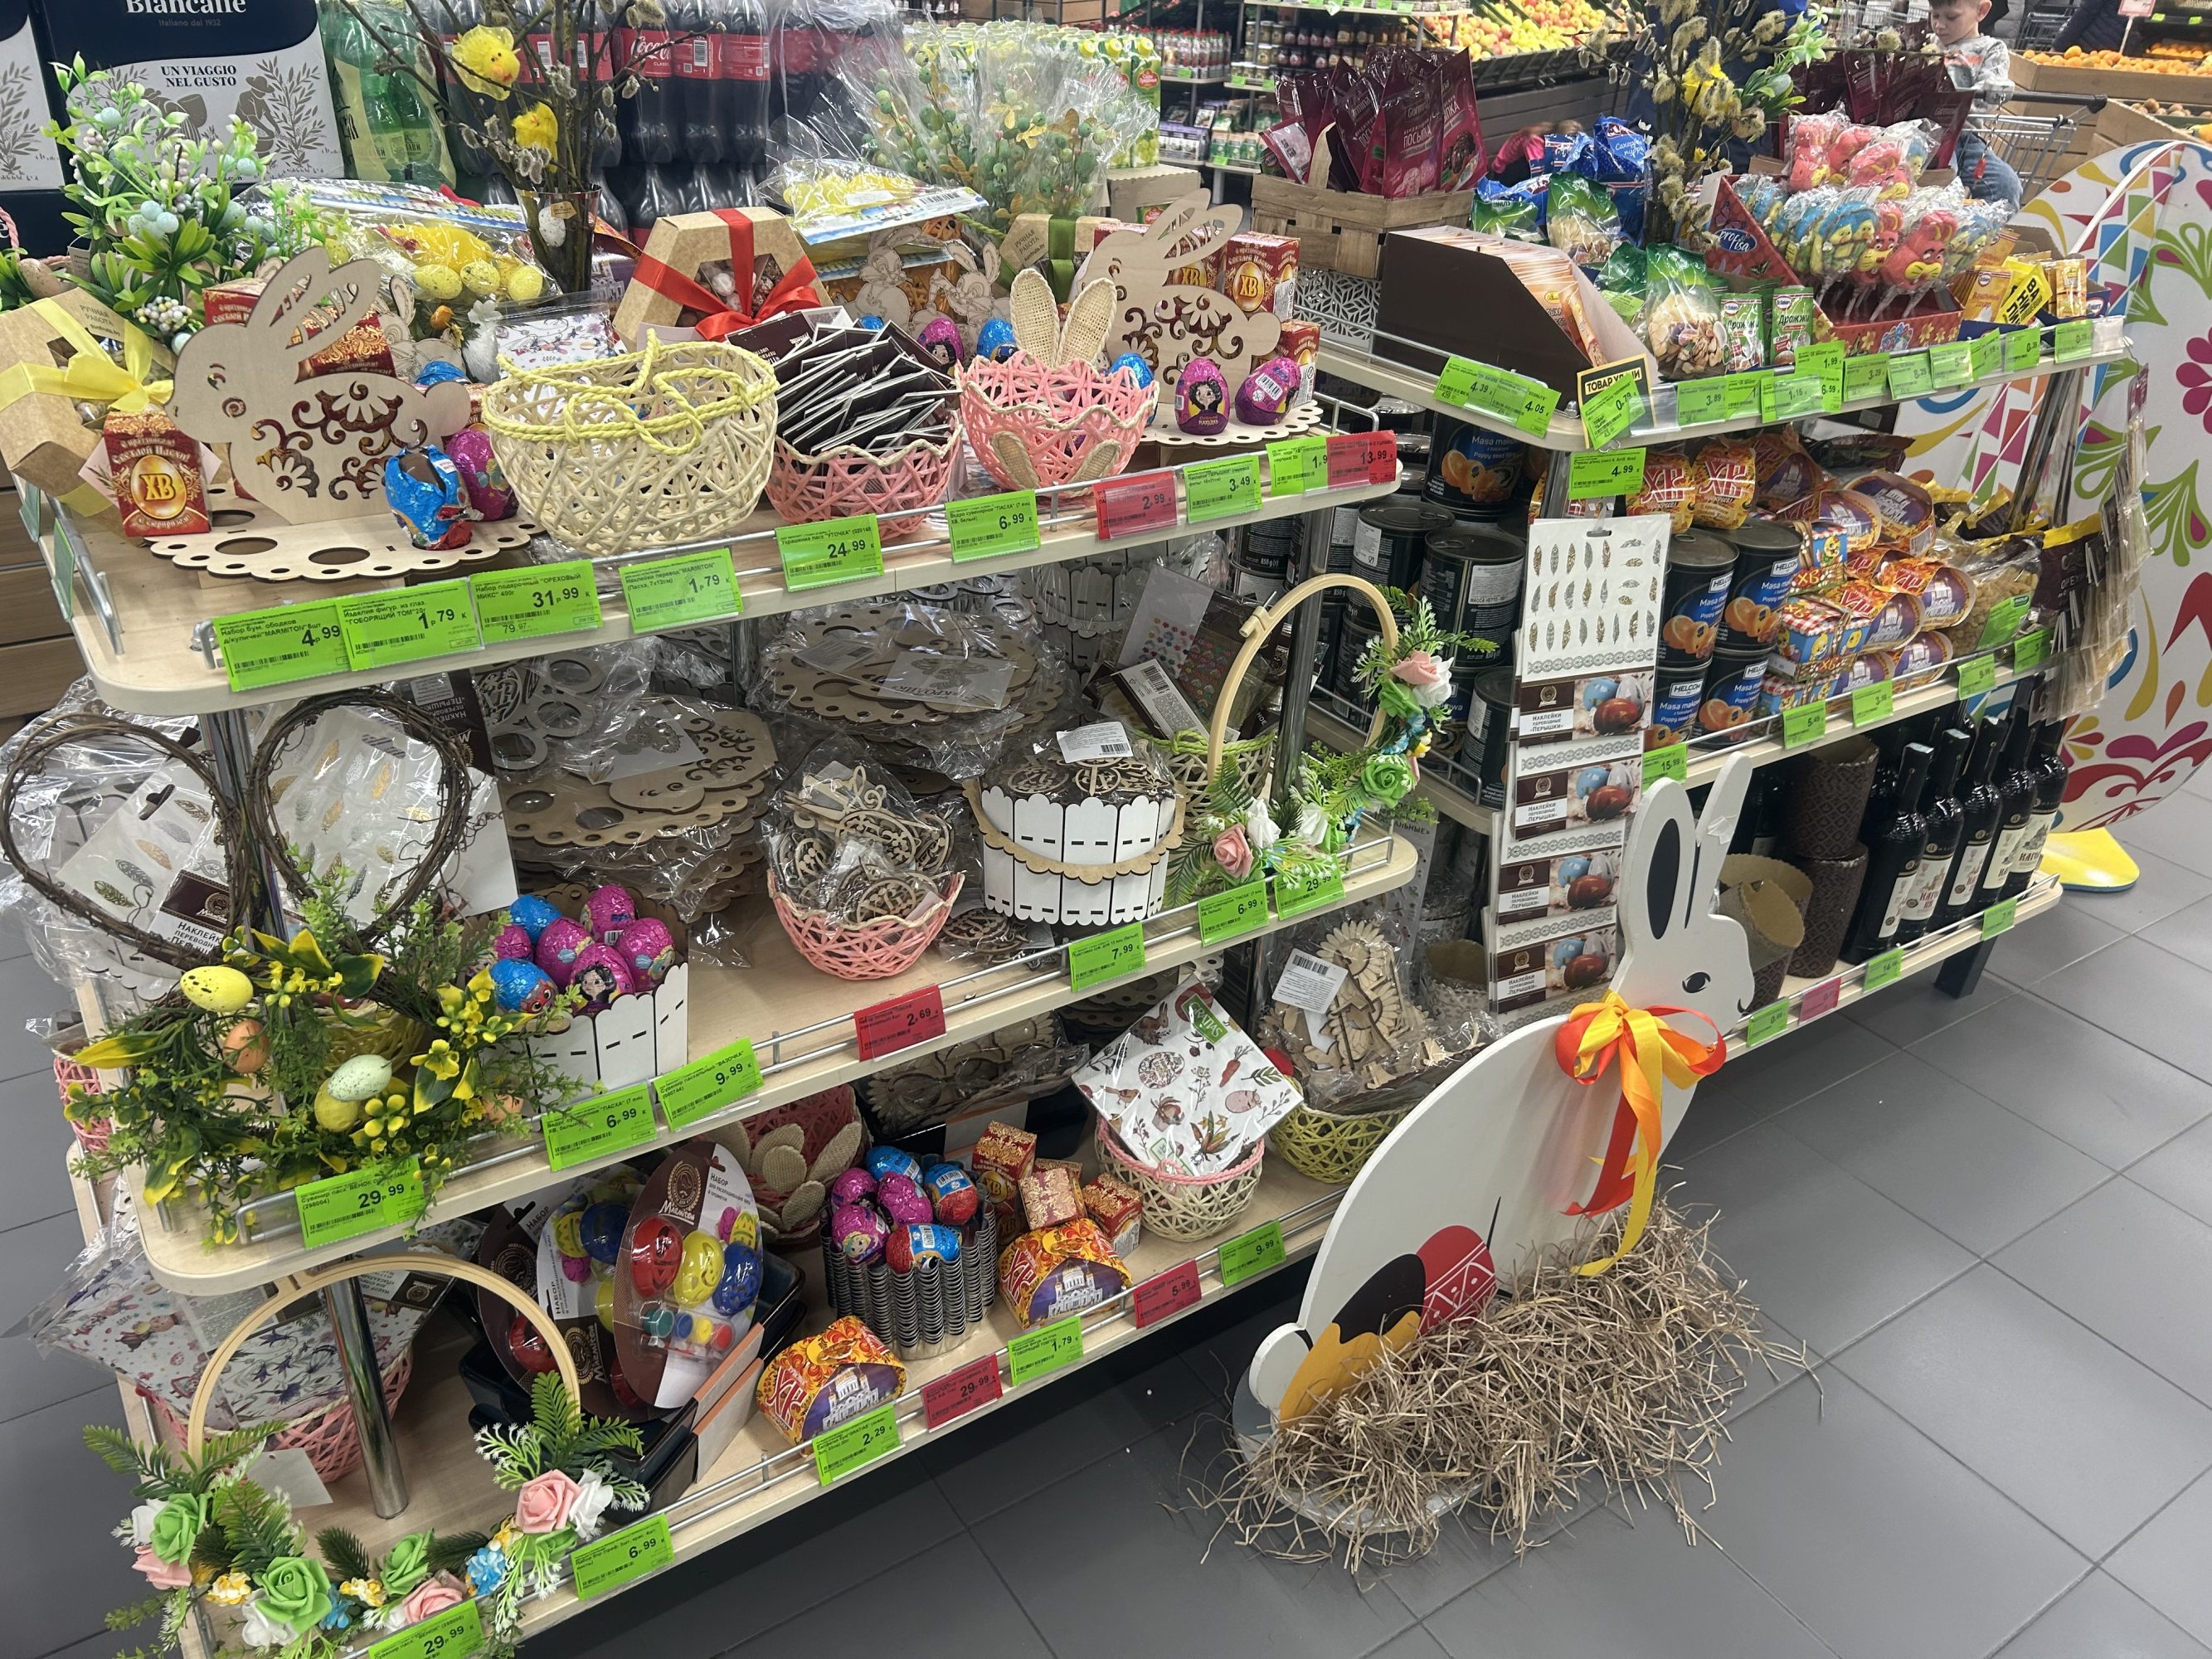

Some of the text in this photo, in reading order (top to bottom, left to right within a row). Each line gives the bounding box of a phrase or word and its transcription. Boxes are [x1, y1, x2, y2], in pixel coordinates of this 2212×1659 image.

[161, 65, 236, 75] UN VIAGGIO
[166, 76, 236, 87] NEL GUSTO
[1015, 229, 1036, 249] РУЧНАЯ
[1018, 237, 1040, 254] РАБОТА
[1239, 275, 1259, 298] ХВ
[1778, 314, 1810, 324] Дрожжи
[1587, 377, 1613, 392] ТОВАР
[1471, 435, 1494, 445] Masa
[112, 446, 191, 465] Светлой Пасхи!
[1474, 451, 1492, 460] Poppy
[139, 474, 176, 501] ХВ
[498, 580, 539, 591] подарочный
[540, 573, 581, 584] "ОРЕХОВЫЙ
[1761, 581, 1781, 590] Masa
[477, 591, 499, 600] МИКС"
[1699, 598, 1718, 607] Masa
[343, 607, 374, 618] Изделия
[410, 600, 427, 608] глаз.
[221, 626, 246, 636] Набор
[246, 624, 264, 633] бум.
[265, 619, 297, 629] ободков
[425, 697, 464, 712] «ПЕРЫШК
[1660, 702, 1680, 710] Masa
[1532, 713, 1562, 722] НАКЛЕЙКИ
[1528, 802, 1556, 811] НАКЛЕЙКИ
[1511, 890, 1539, 899] НАКЛЕЙКИ
[174, 930, 216, 950] ПЕРЕВОДН
[177, 922, 223, 944] НАКЛЕЙК
[168, 936, 209, 956] «ПЕРЫШ
[1508, 974, 1535, 985] НАКЛЕЙКИ
[1190, 1000, 1223, 1039] GRATIAS
[659, 1050, 744, 1093] Сувенир пасхальный "ВАЗОЧКА"
[600, 1100, 625, 1112] "ПАСХА"
[710, 1172, 729, 1187] НАБОР
[301, 1192, 330, 1204] Сувенир
[526, 1206, 549, 1229] НАБОР
